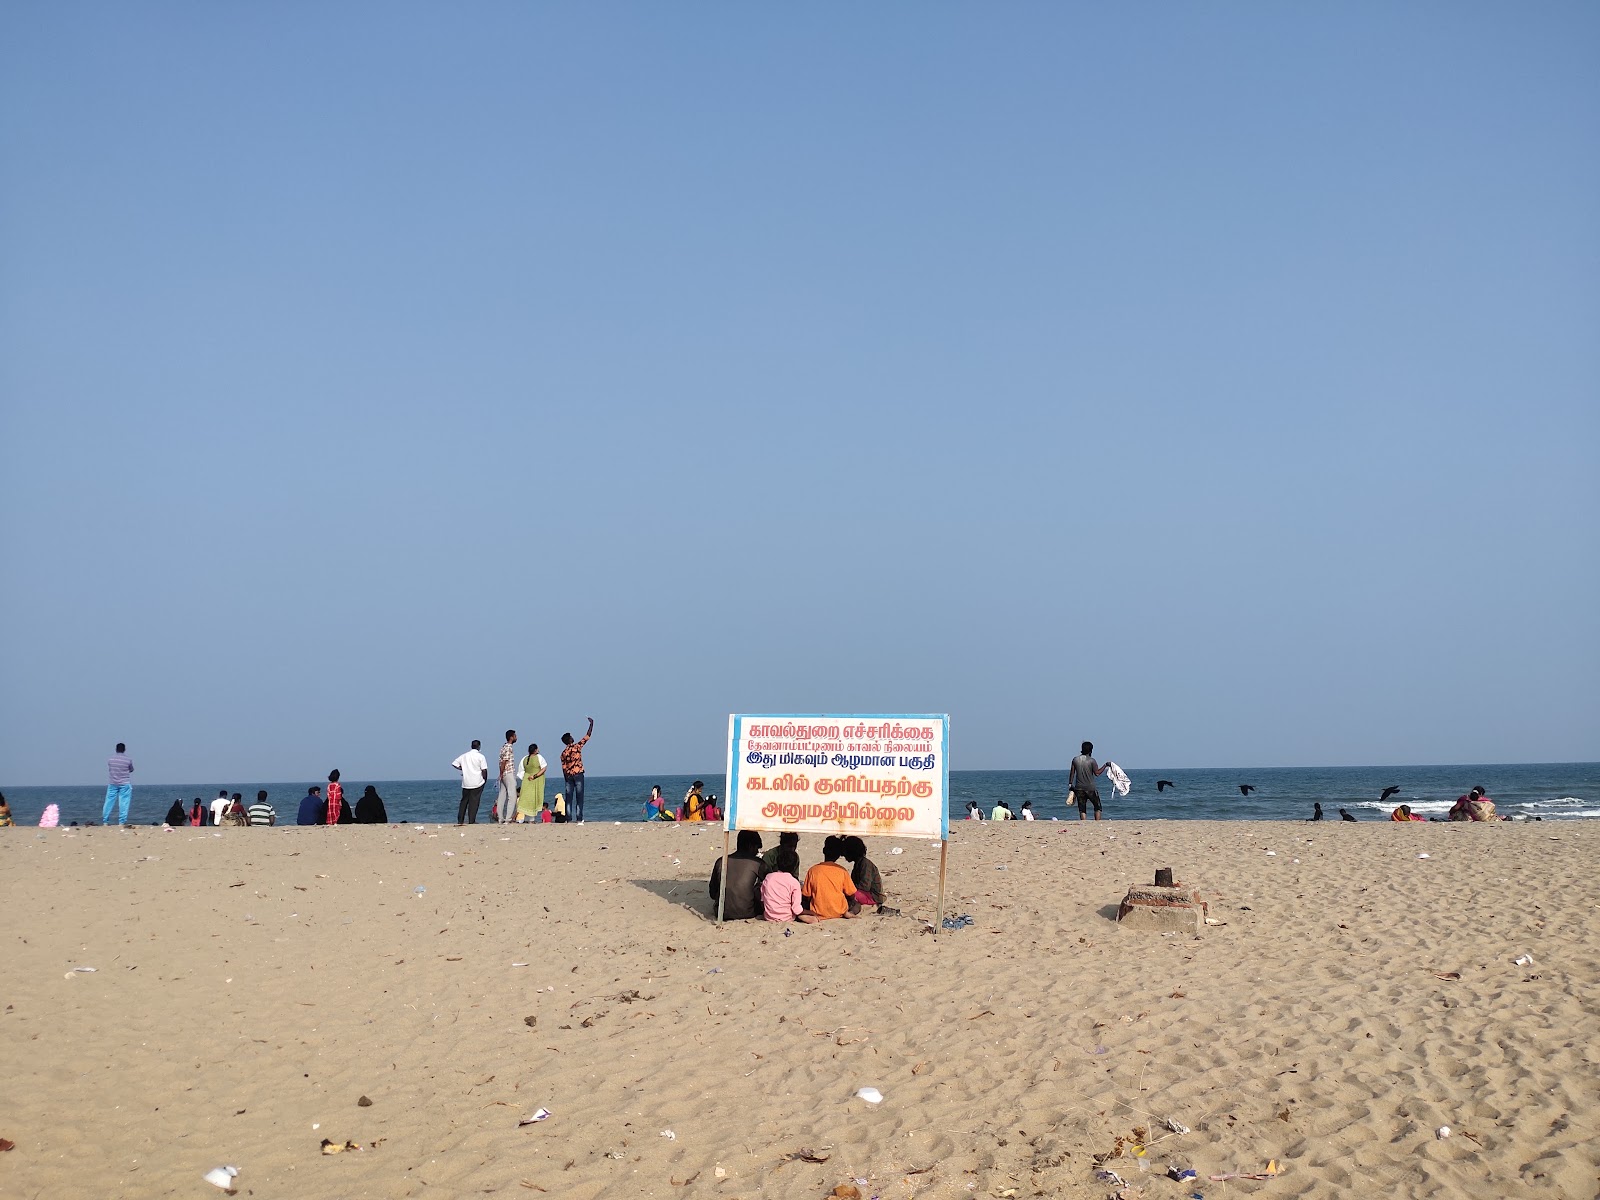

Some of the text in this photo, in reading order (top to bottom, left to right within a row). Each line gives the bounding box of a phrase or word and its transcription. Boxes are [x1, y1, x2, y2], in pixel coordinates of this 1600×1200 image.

[749, 722, 934, 741] காவல்துறை எச்சரிக்கை
[847, 740, 881, 752] காவல்
[884, 740, 932, 753] நிலையம்
[747, 751, 935, 770] இது மிகவும் ஆழமான பகுதி
[747, 774, 933, 798] கடலில் குளிப்பதற்கு
[761, 801, 915, 823] அனுமதியில்லை
